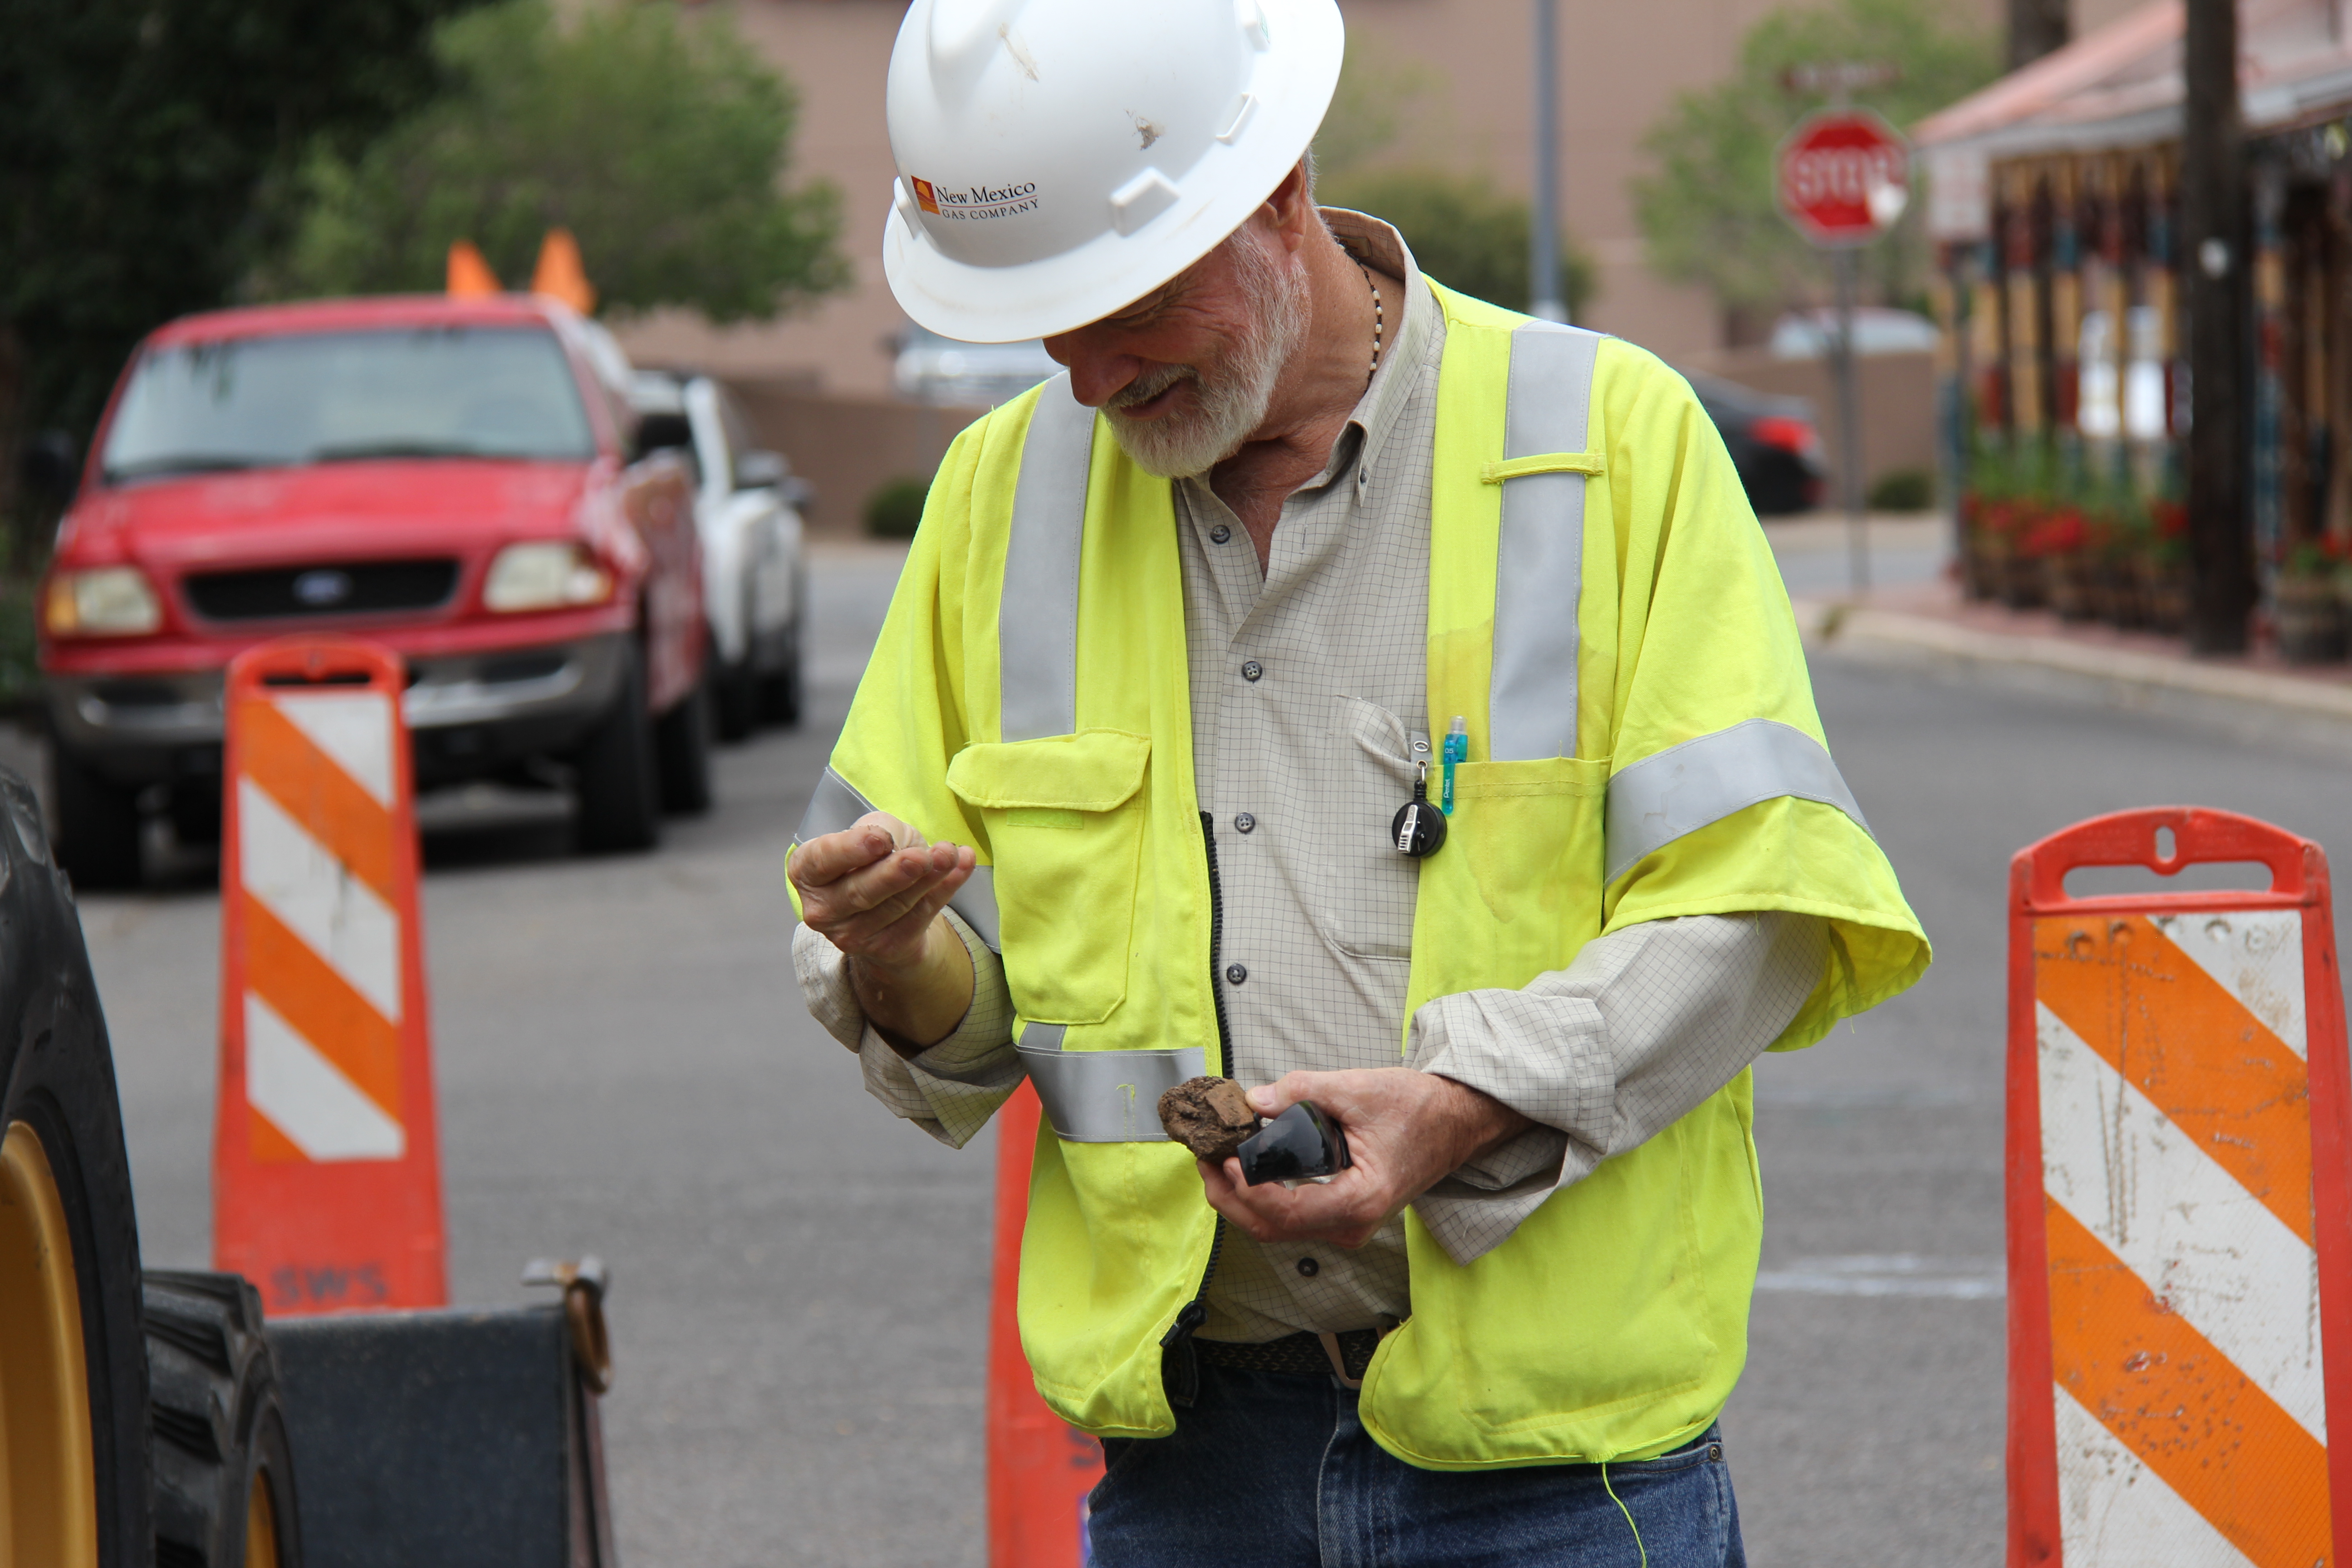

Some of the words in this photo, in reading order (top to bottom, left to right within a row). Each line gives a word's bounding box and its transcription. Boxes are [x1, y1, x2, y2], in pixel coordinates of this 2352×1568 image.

[935, 186, 967, 204] New
[970, 182, 1035, 203] Mexico
[942, 209, 965, 220] GAS
[970, 199, 1039, 220] COMPANY
